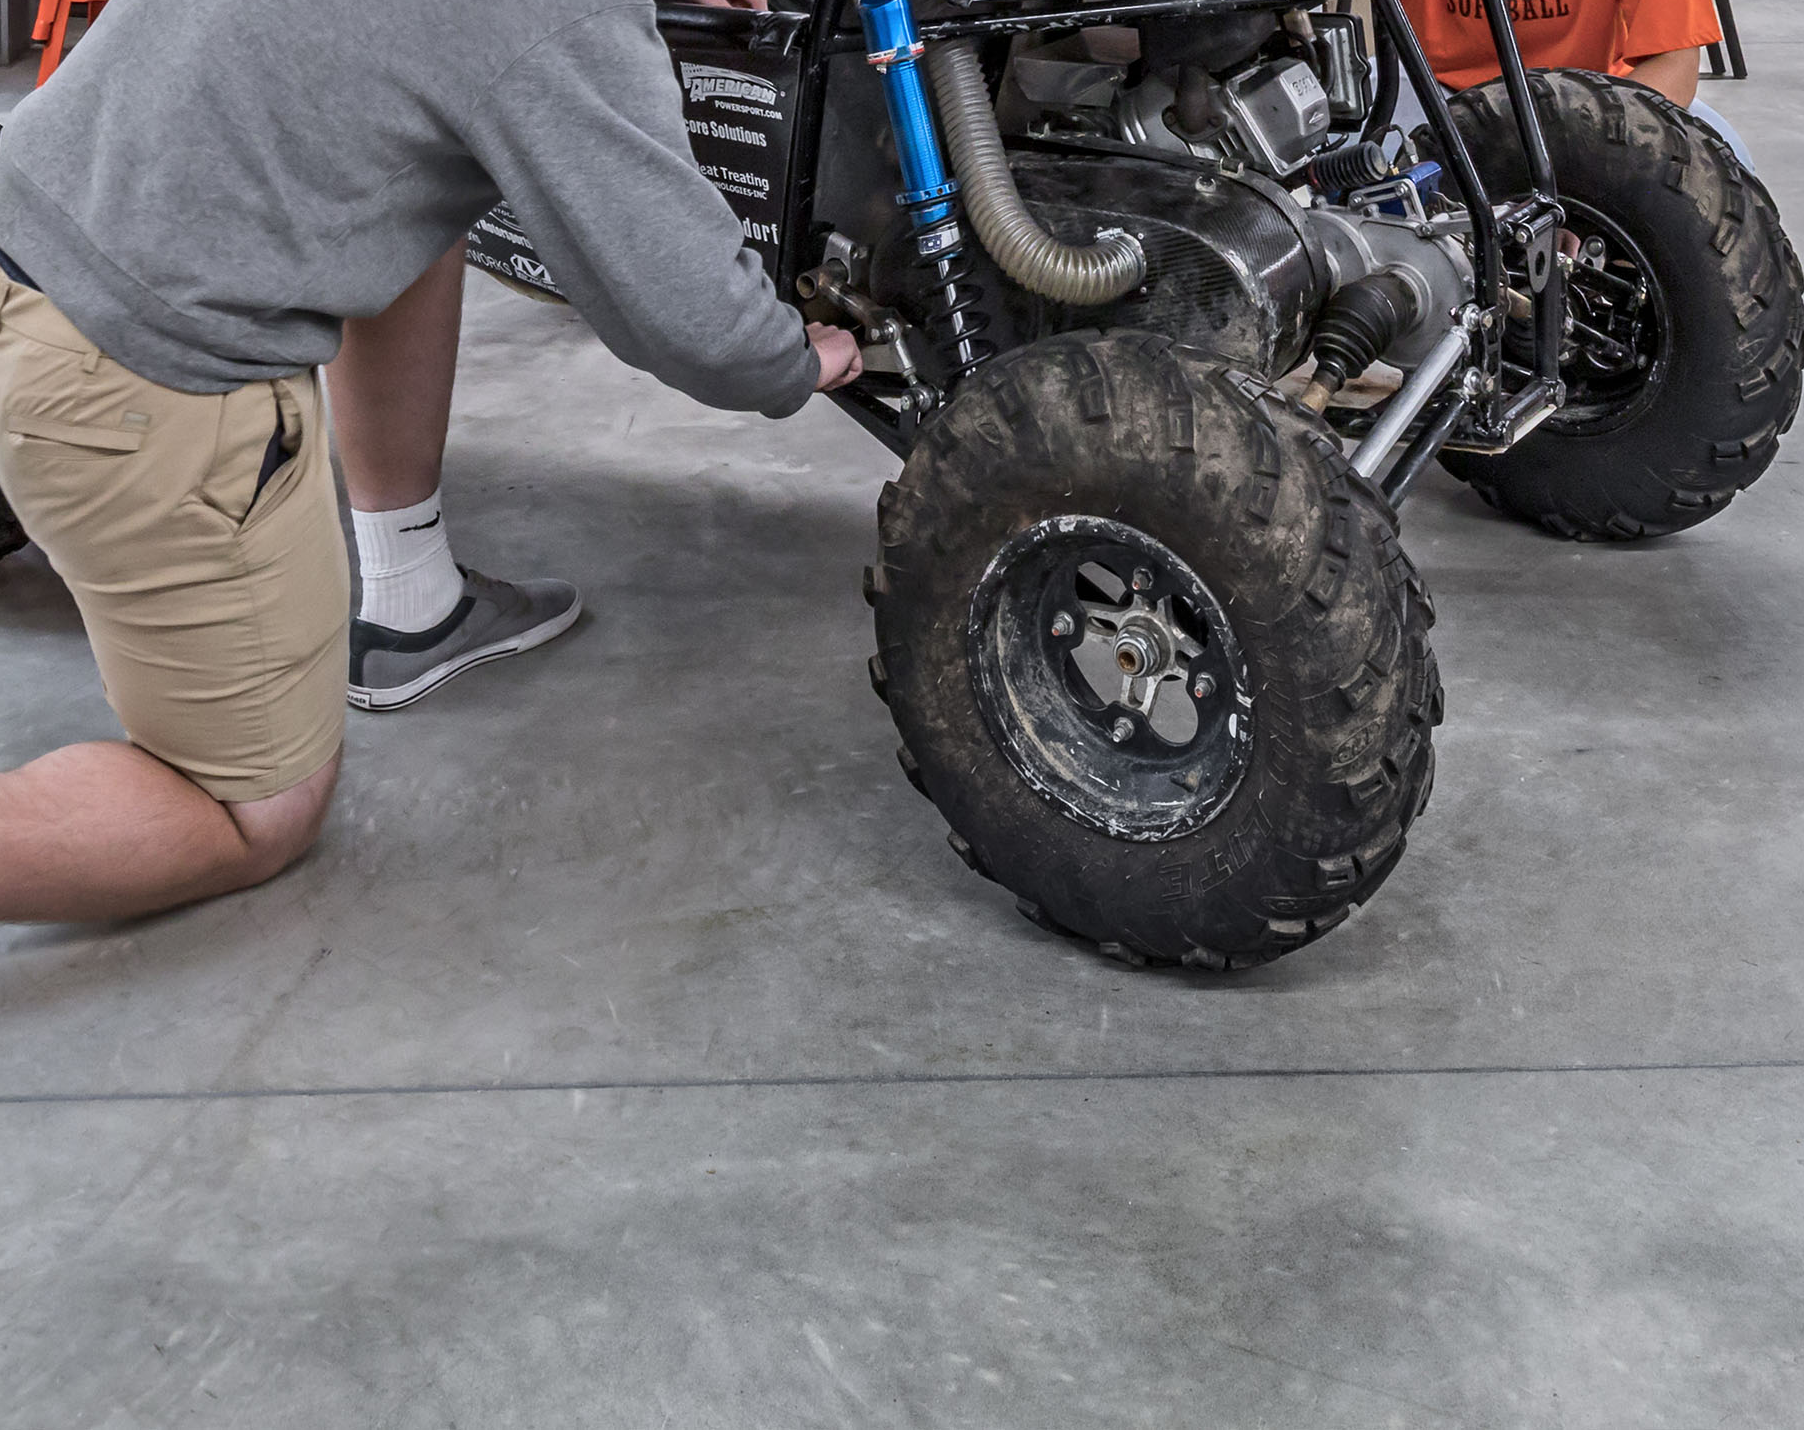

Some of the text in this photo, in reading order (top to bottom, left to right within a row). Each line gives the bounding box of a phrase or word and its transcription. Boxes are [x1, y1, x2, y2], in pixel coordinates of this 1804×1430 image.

[690, 77, 777, 106] AMERICAN
[714, 100, 783, 121] POWERSPORT.COM
[711, 121, 767, 147] Solutions
[698, 164, 770, 192] eat Treating
[711, 180, 768, 200] NOLOGIES-INC
[743, 216, 779, 245] dorf
[467, 249, 513, 277] WORKS
